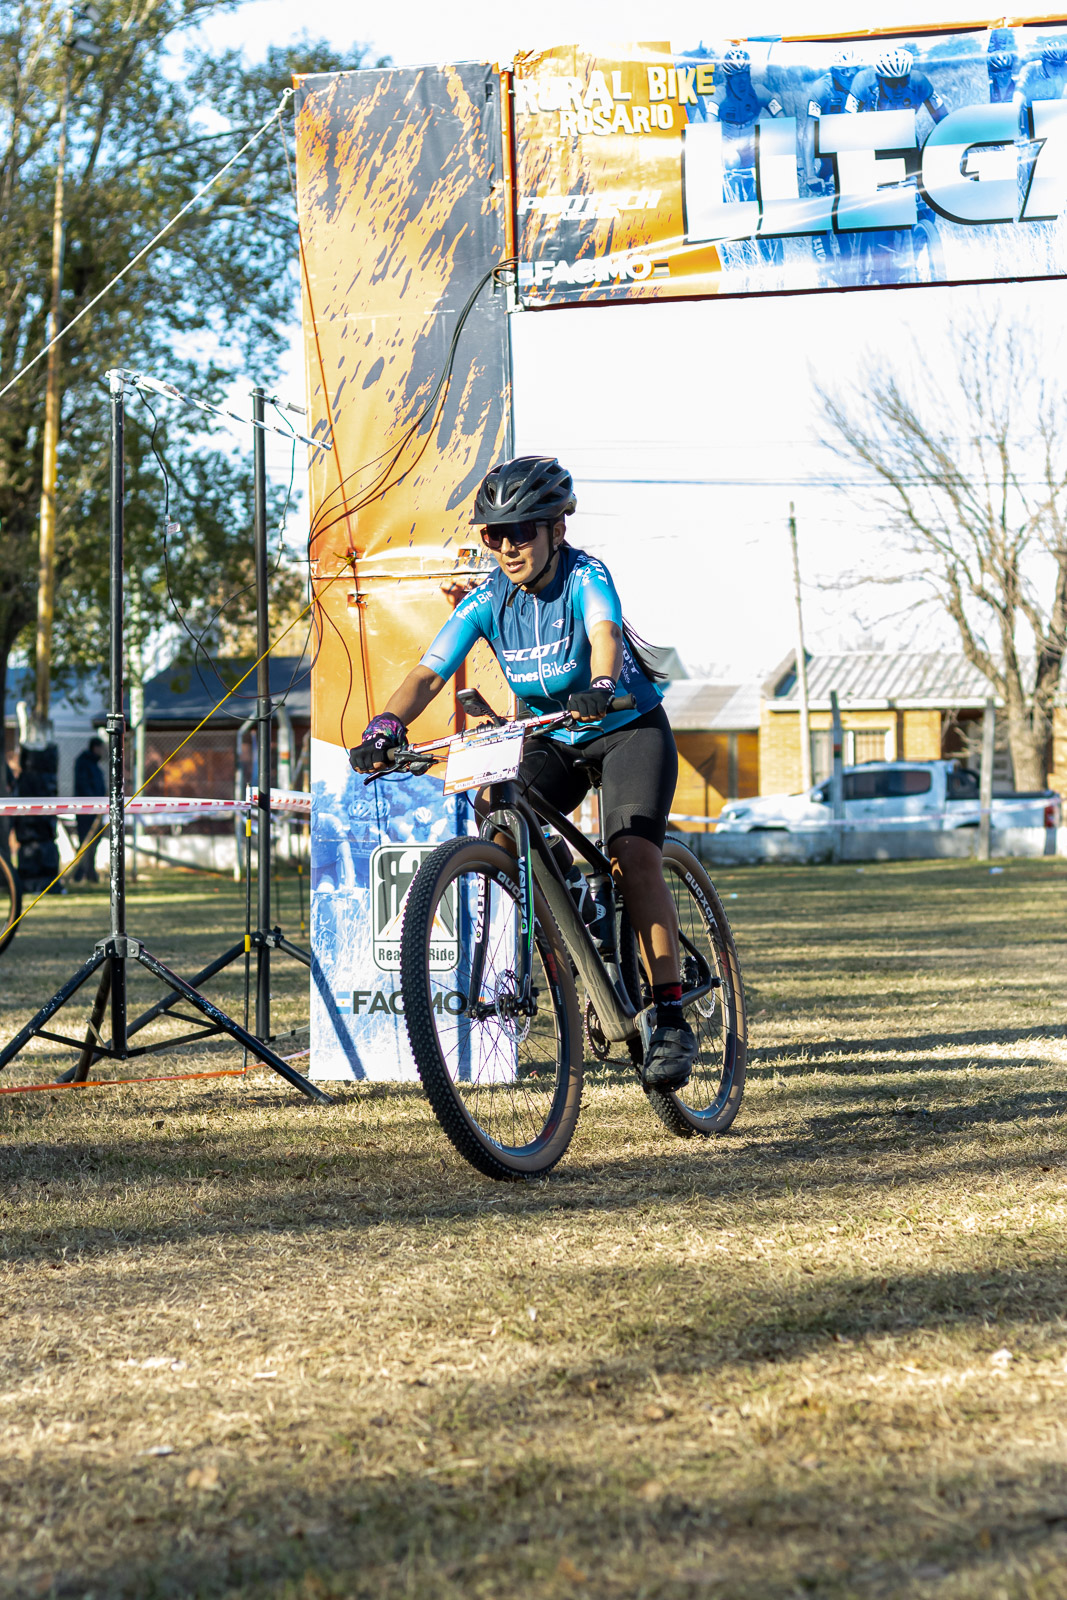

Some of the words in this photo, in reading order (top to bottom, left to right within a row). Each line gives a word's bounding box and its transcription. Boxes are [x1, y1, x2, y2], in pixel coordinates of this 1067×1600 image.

[514, 70, 632, 114] RURAL
[647, 63, 715, 105] BIKE
[560, 103, 674, 137] ROSARIO
[502, 634, 573, 662] SCOTT
[505, 665, 539, 683] Funes
[541, 658, 577, 679] Bikes
[378, 948, 401, 961] Rea
[428, 948, 455, 961] Ride
